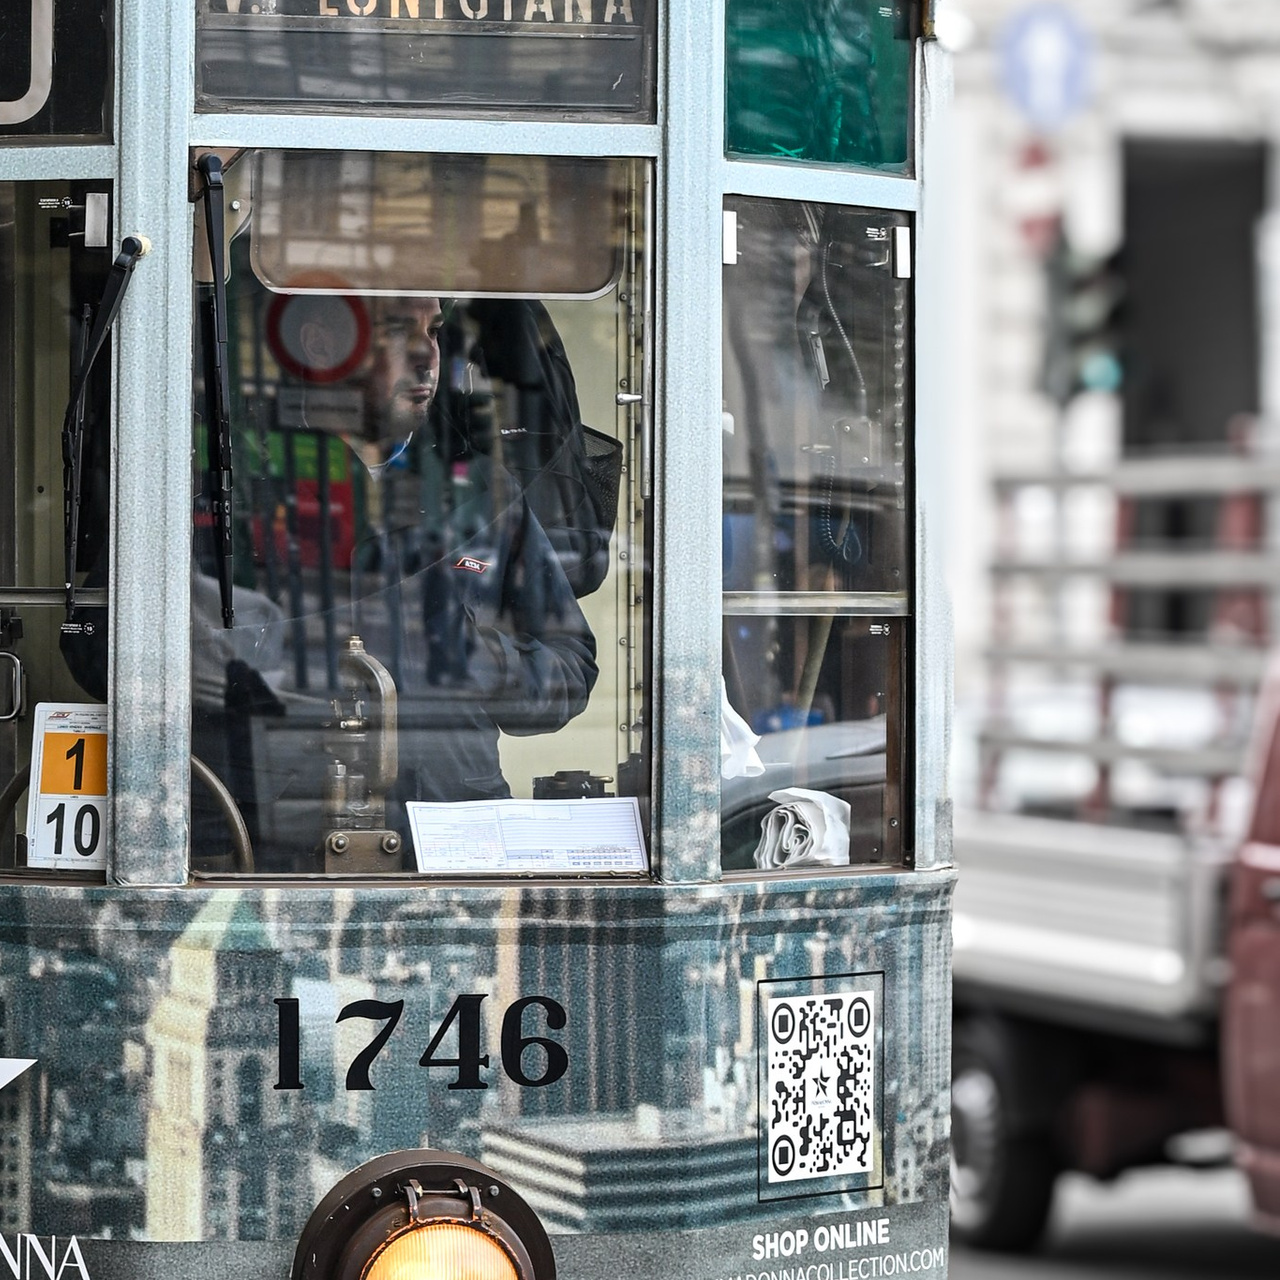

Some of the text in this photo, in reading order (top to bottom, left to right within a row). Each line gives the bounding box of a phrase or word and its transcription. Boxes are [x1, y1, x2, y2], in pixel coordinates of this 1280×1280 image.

[65, 737, 86, 791] 1
[46, 802, 101, 857] 10
[273, 993, 569, 1091] 1746
[751, 1218, 891, 1262] SHOP ONLINE
